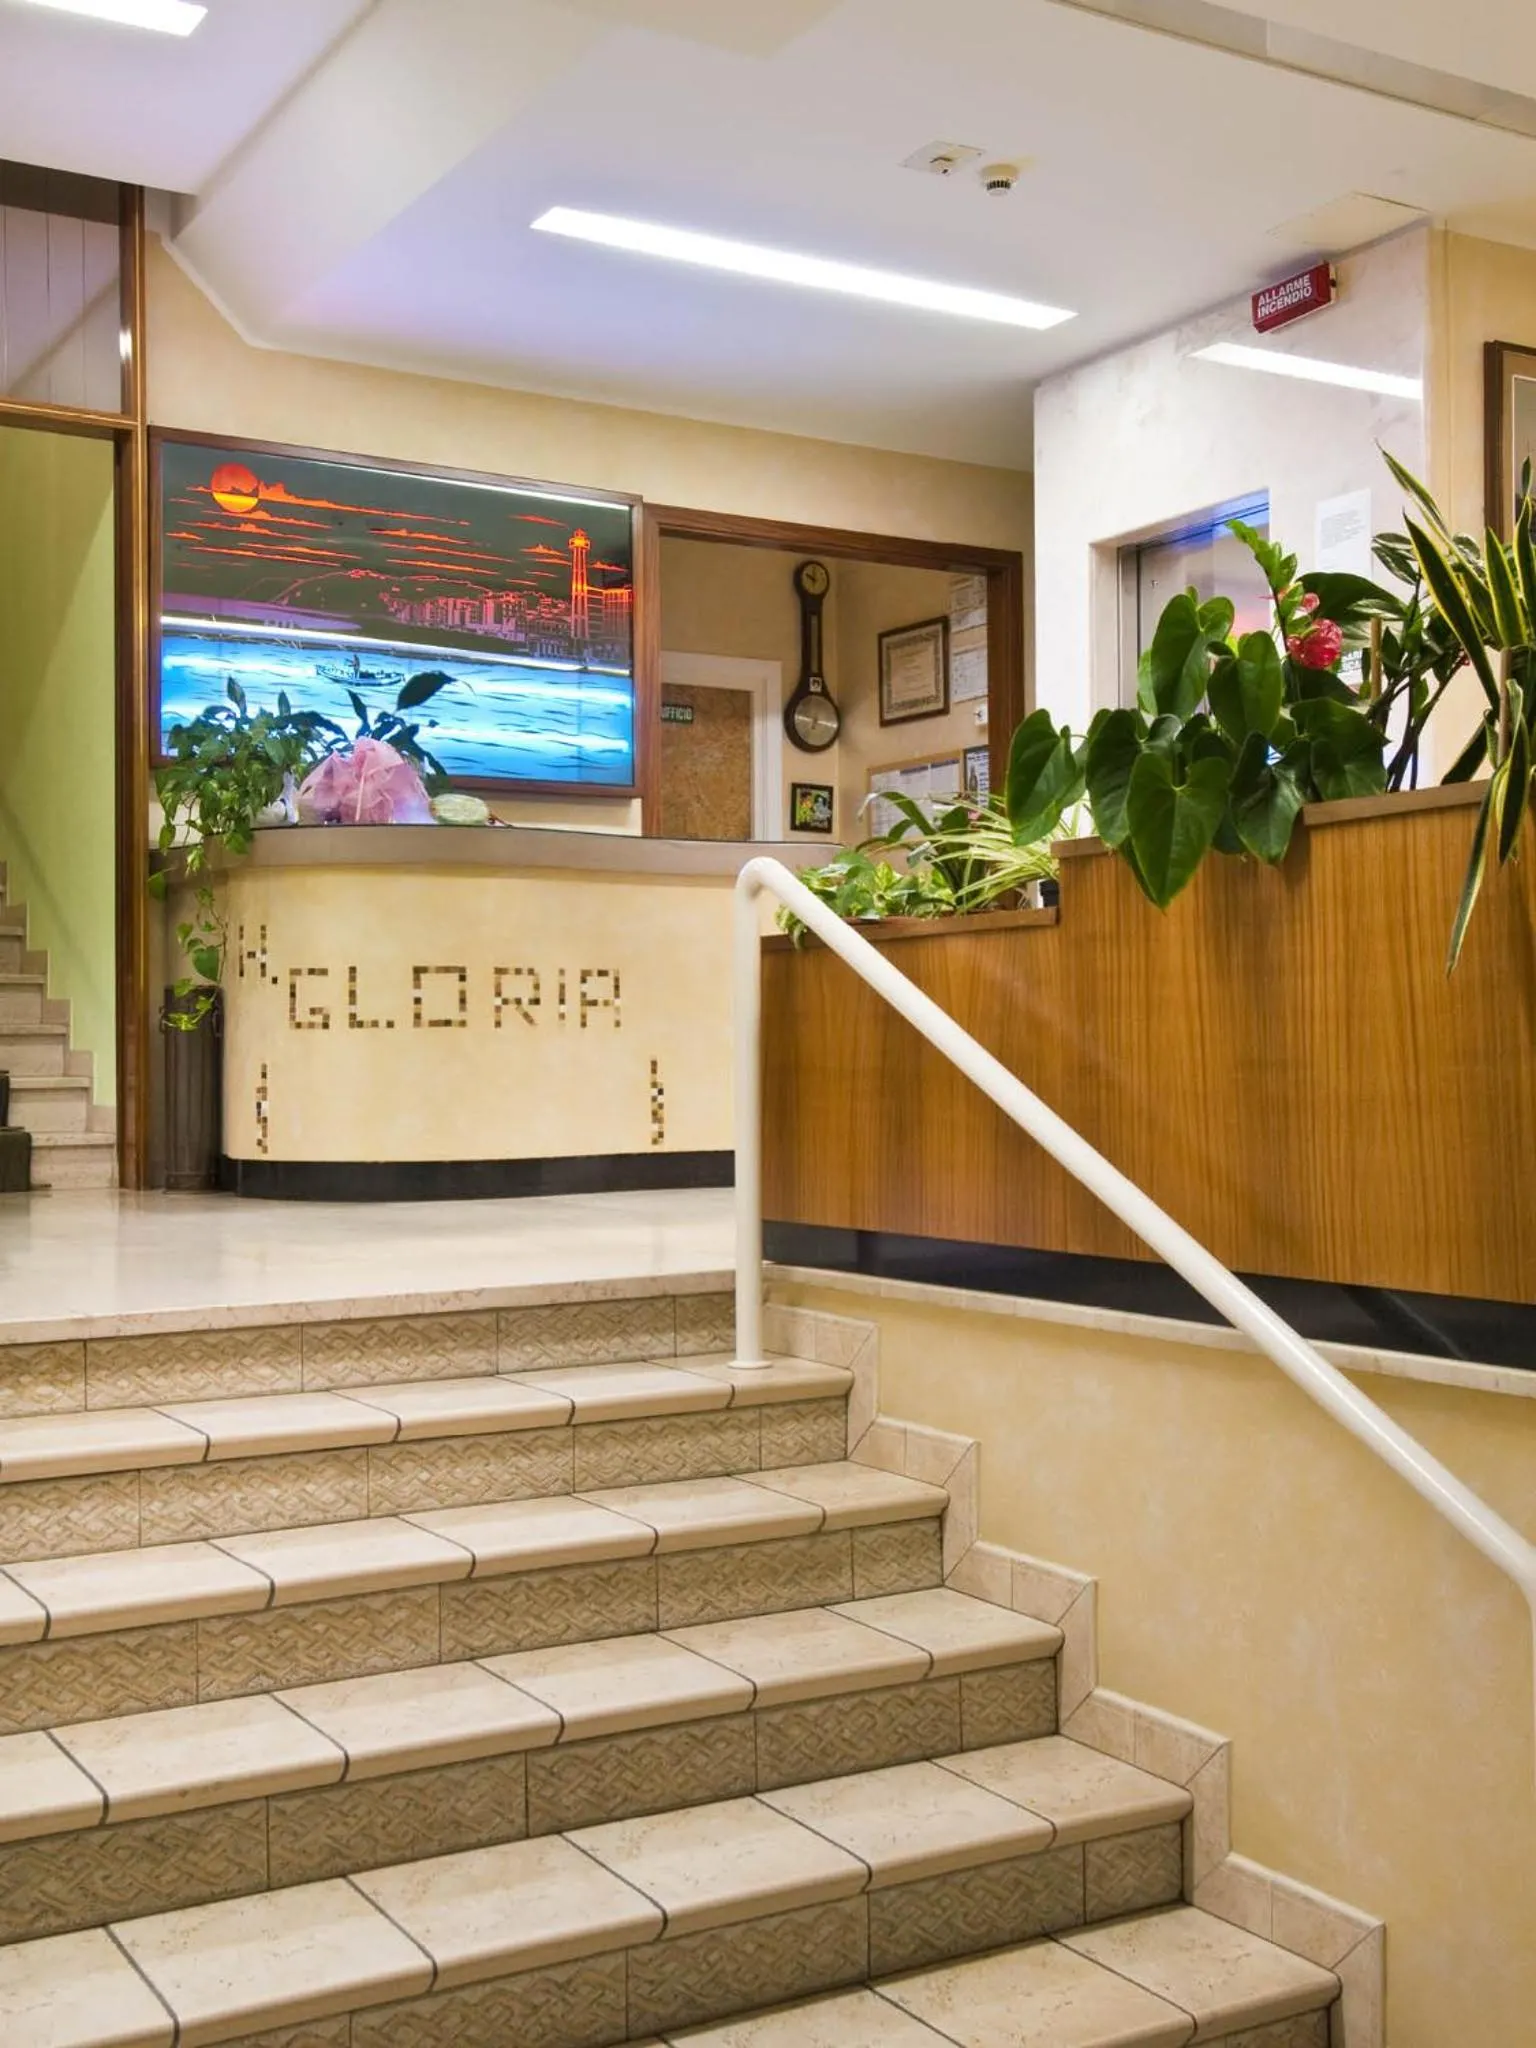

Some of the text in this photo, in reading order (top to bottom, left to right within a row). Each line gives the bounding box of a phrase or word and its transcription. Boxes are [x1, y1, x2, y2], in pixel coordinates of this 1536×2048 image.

[1257, 286, 1312, 318] INCENDIO
[1258, 274, 1311, 307] ALLARME
[289, 966, 620, 1029] GLORIA
